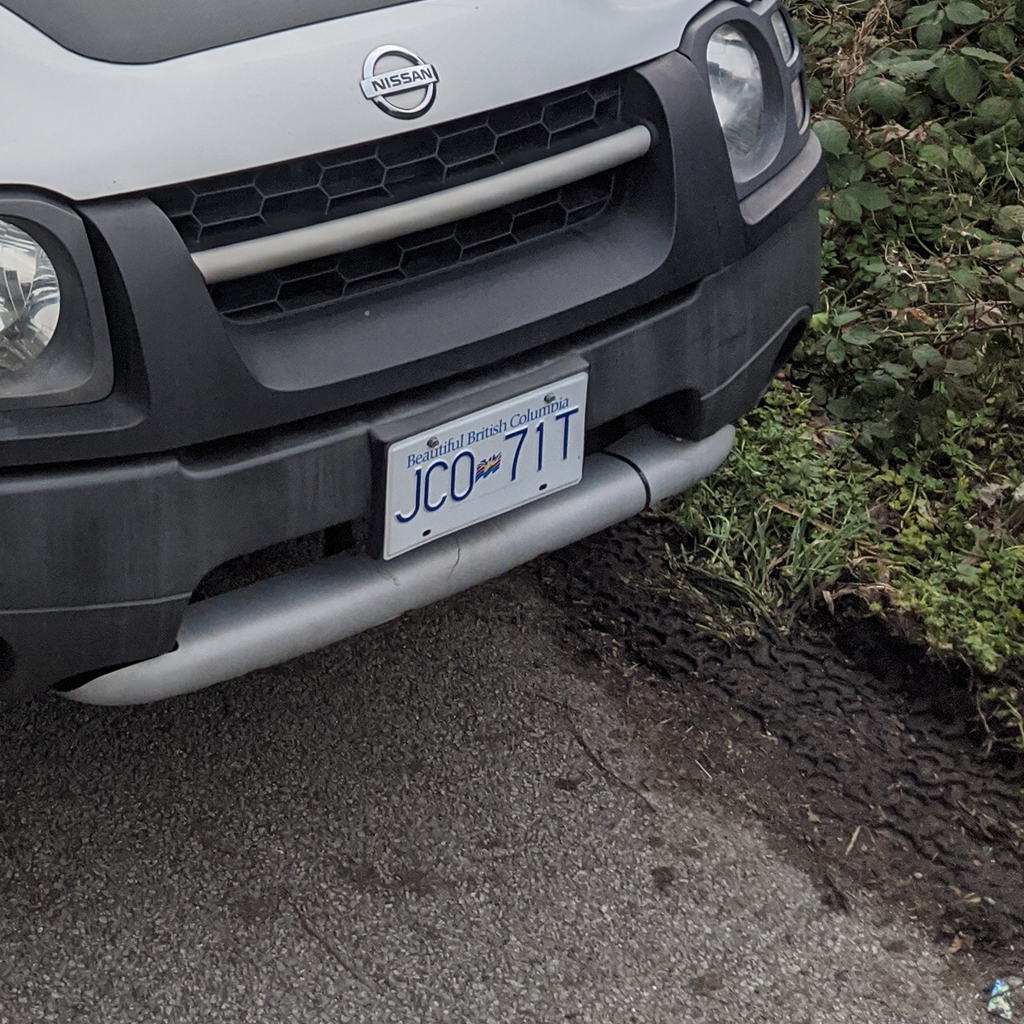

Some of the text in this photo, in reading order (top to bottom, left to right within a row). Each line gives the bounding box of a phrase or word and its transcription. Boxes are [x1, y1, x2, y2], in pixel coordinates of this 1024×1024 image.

[371, 67, 433, 92] NISSAN
[407, 397, 569, 469] Beautiful British Columbia
[504, 407, 579, 482] 71T
